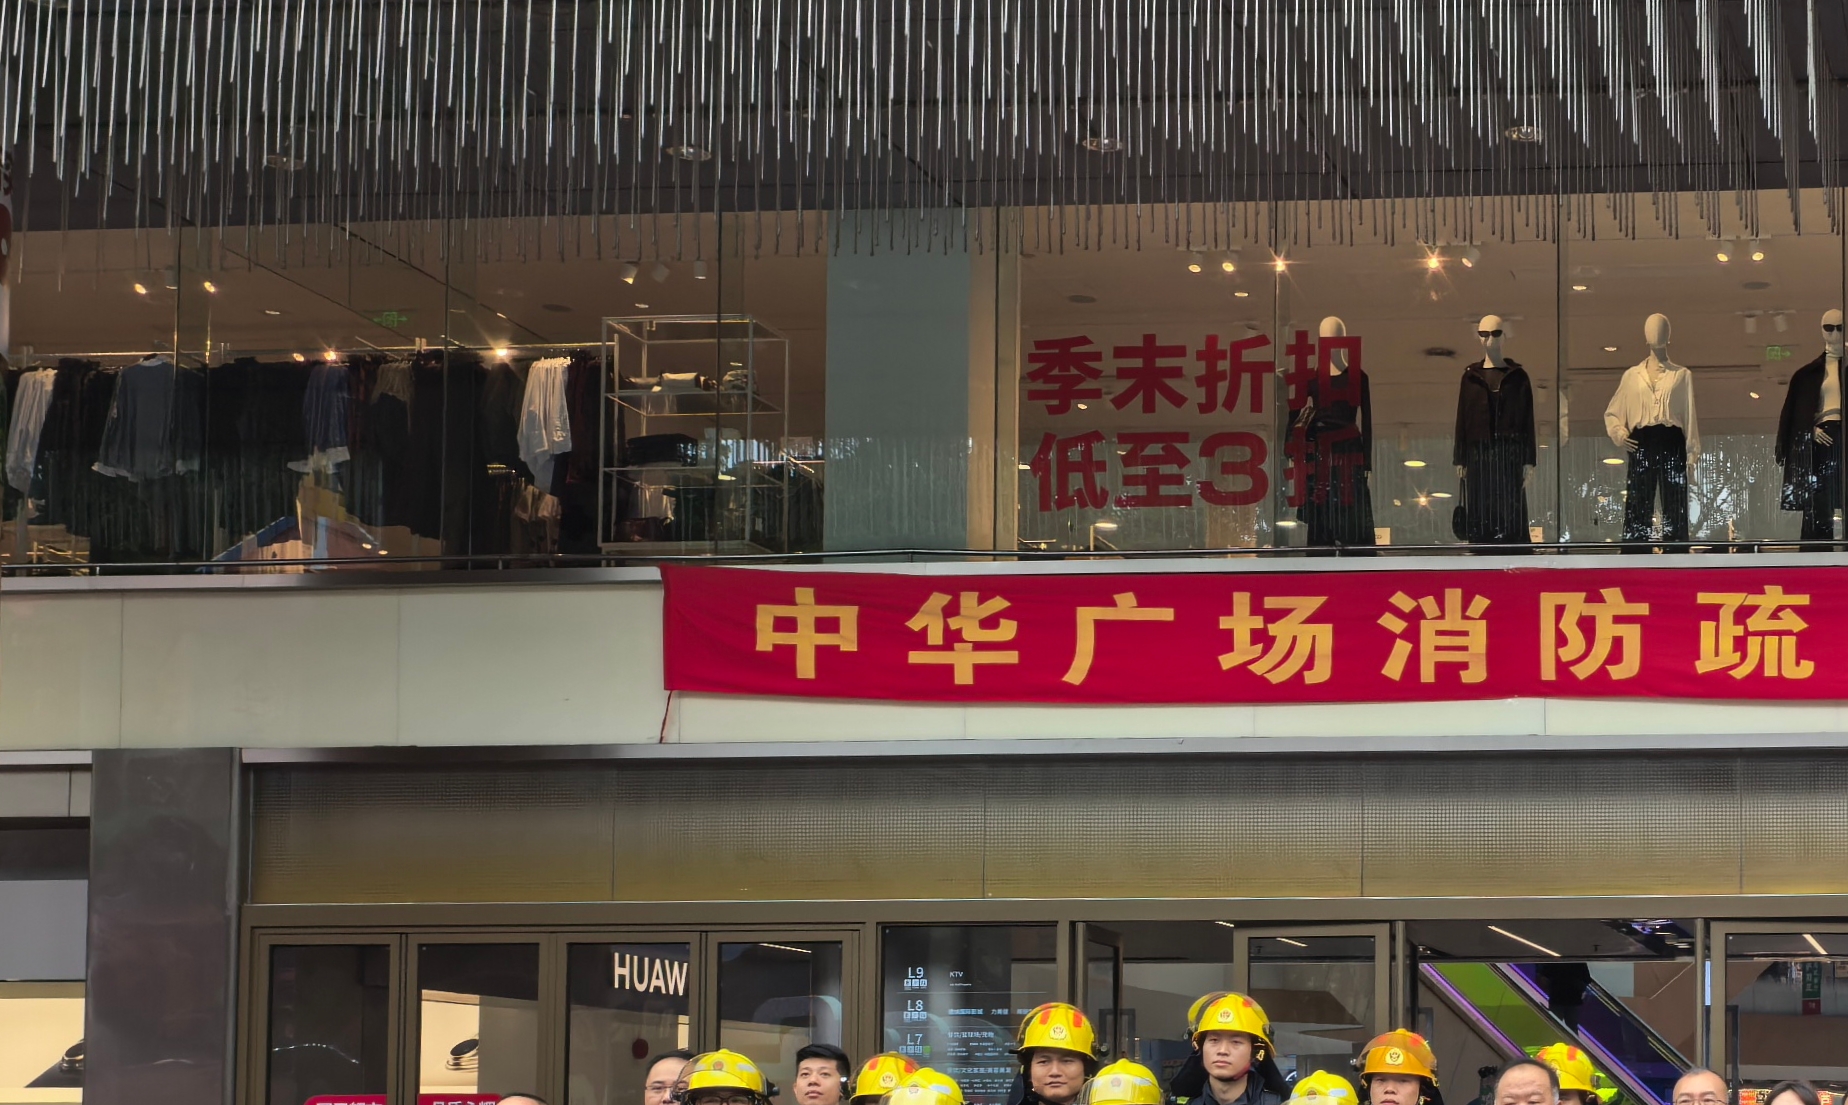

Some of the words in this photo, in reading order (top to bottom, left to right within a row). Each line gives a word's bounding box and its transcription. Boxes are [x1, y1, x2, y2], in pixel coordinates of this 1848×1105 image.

[1026, 330, 1362, 416] 季末折扣
[1030, 424, 1365, 513] 低至3折
[614, 952, 689, 996] HUAW
[908, 967, 924, 979] L9
[907, 1000, 924, 1011] L8
[906, 1033, 923, 1045] L7
